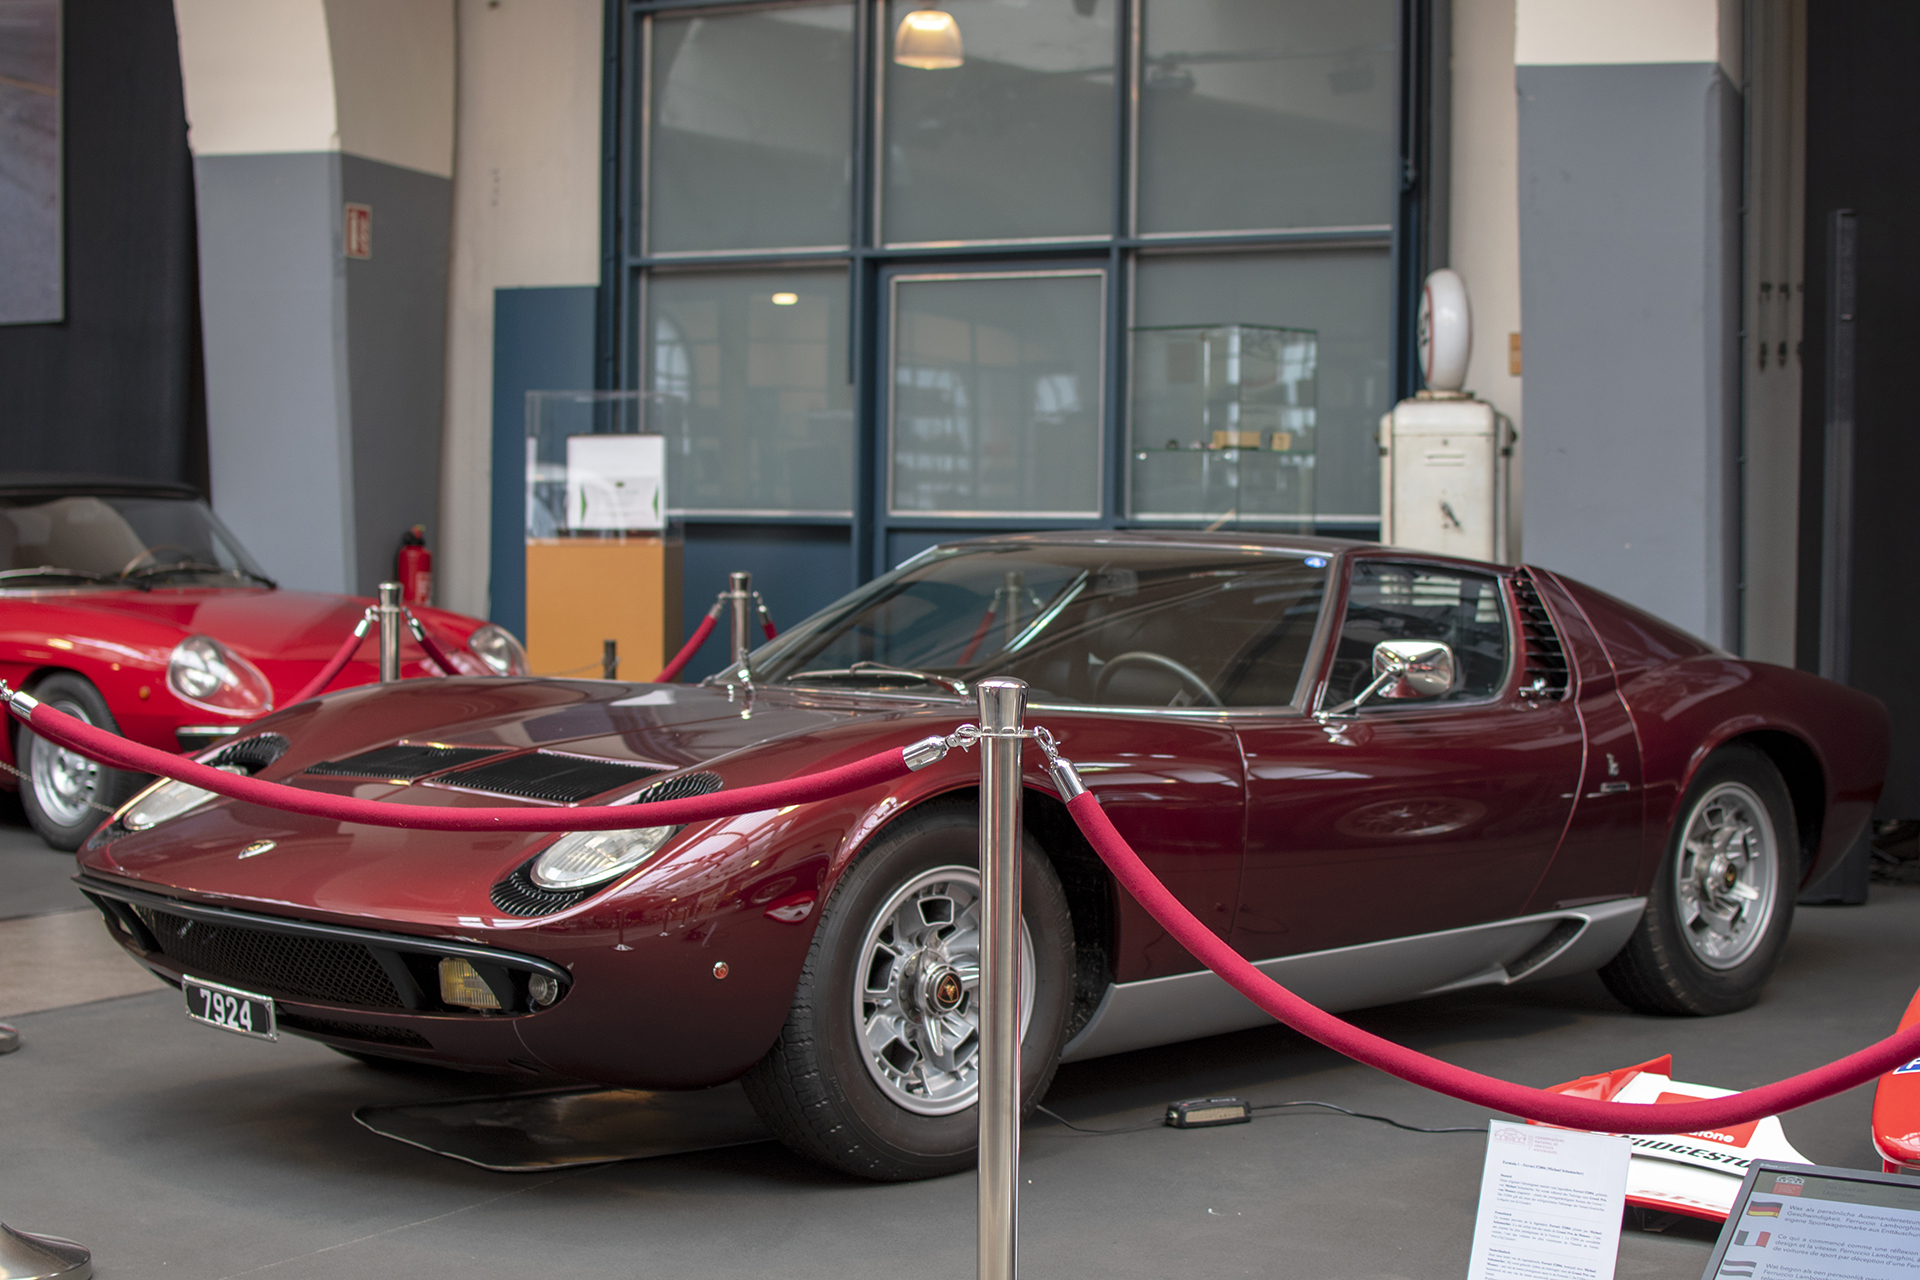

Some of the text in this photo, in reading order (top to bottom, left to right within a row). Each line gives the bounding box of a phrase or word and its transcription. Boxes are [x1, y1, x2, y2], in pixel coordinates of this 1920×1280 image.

[199, 988, 252, 1031] 7924
[1817, 1208, 1855, 1217] persönliche
[1808, 1219, 1867, 1231] Sportwagenmarke
[1845, 1218, 1876, 1226] Ferruccio
[1775, 1240, 1797, 1248] design
[1839, 1248, 1870, 1256] Ferruccio
[1808, 1238, 1845, 1247] commencé
[1890, 1248, 1919, 1256] réflexion
[1819, 1252, 1837, 1260] sport
[1851, 1256, 1884, 1265] déception
[1763, 1269, 1794, 1277] Ferruccio
[1780, 1265, 1801, 1273] begon
[1827, 1272, 1863, 1280] persoonlijk
